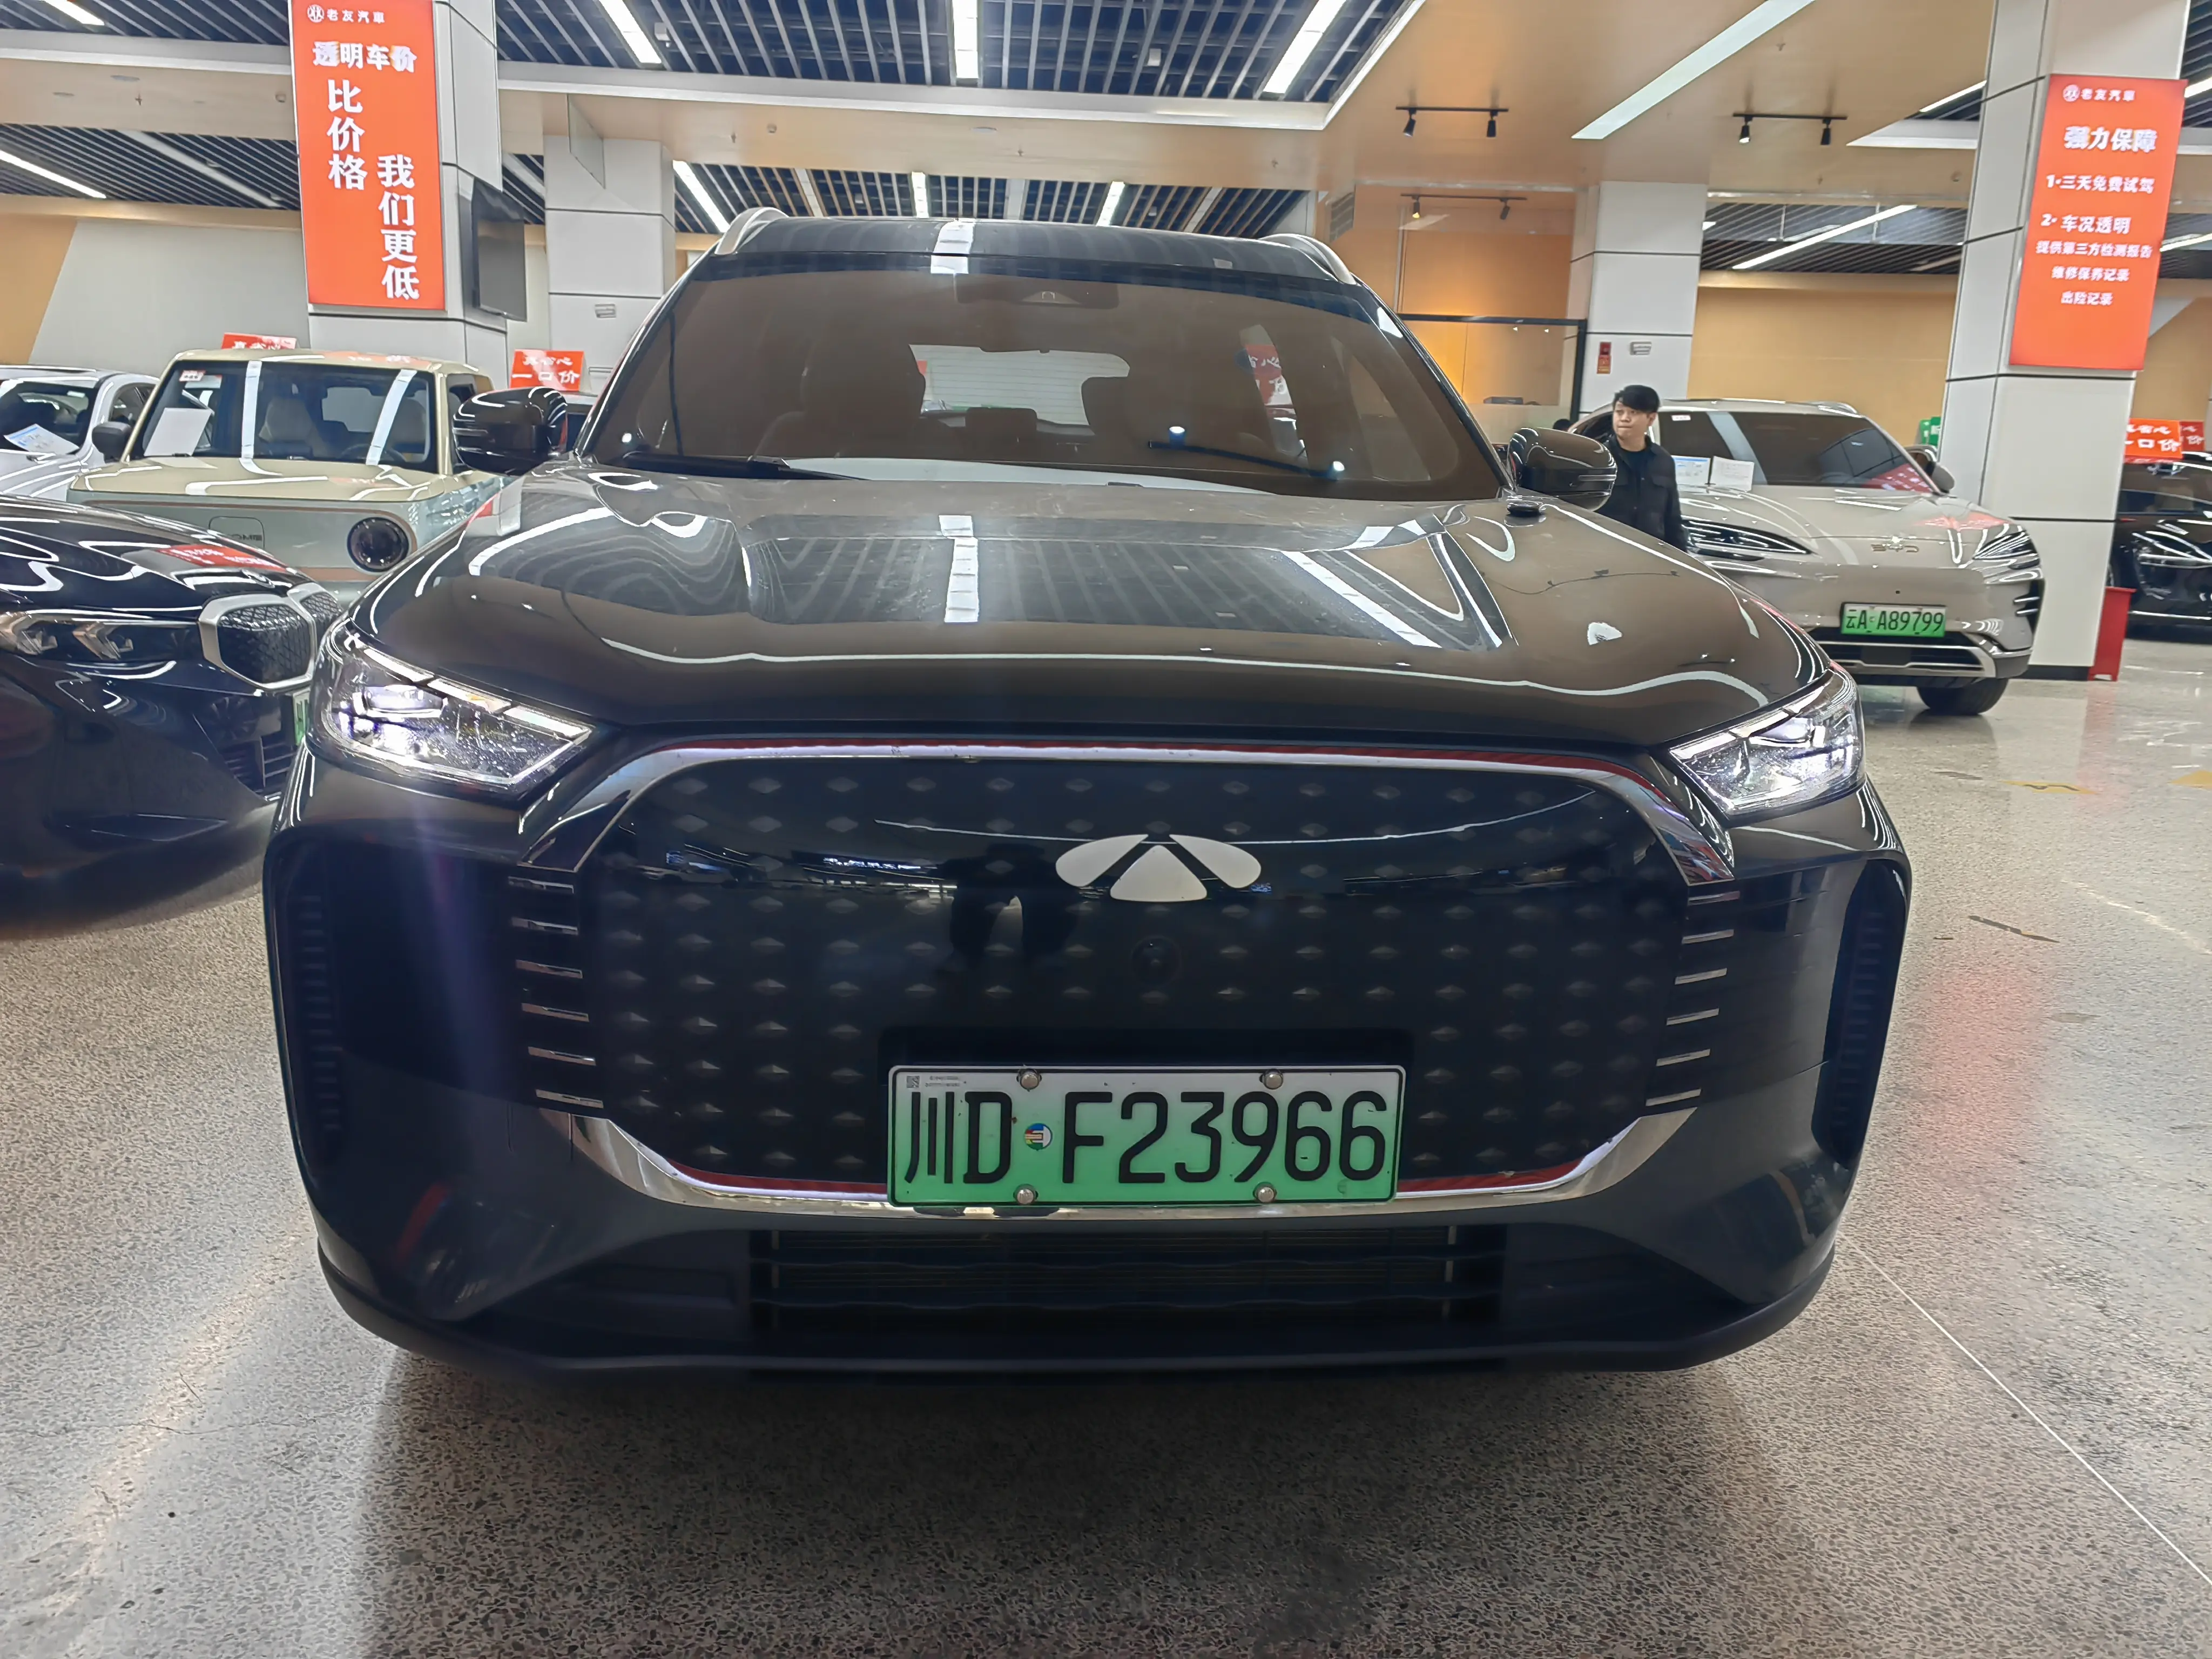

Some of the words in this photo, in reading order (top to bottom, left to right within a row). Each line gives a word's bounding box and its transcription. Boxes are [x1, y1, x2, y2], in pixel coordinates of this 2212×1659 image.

[312, 41, 417, 73] 透明车价
[326, 79, 368, 191] 比价格
[2064, 126, 2158, 153] 强力保障
[377, 154, 420, 300] 我们更低
[2061, 291, 2113, 306] 出险记录
[512, 369, 580, 384] 一口价
